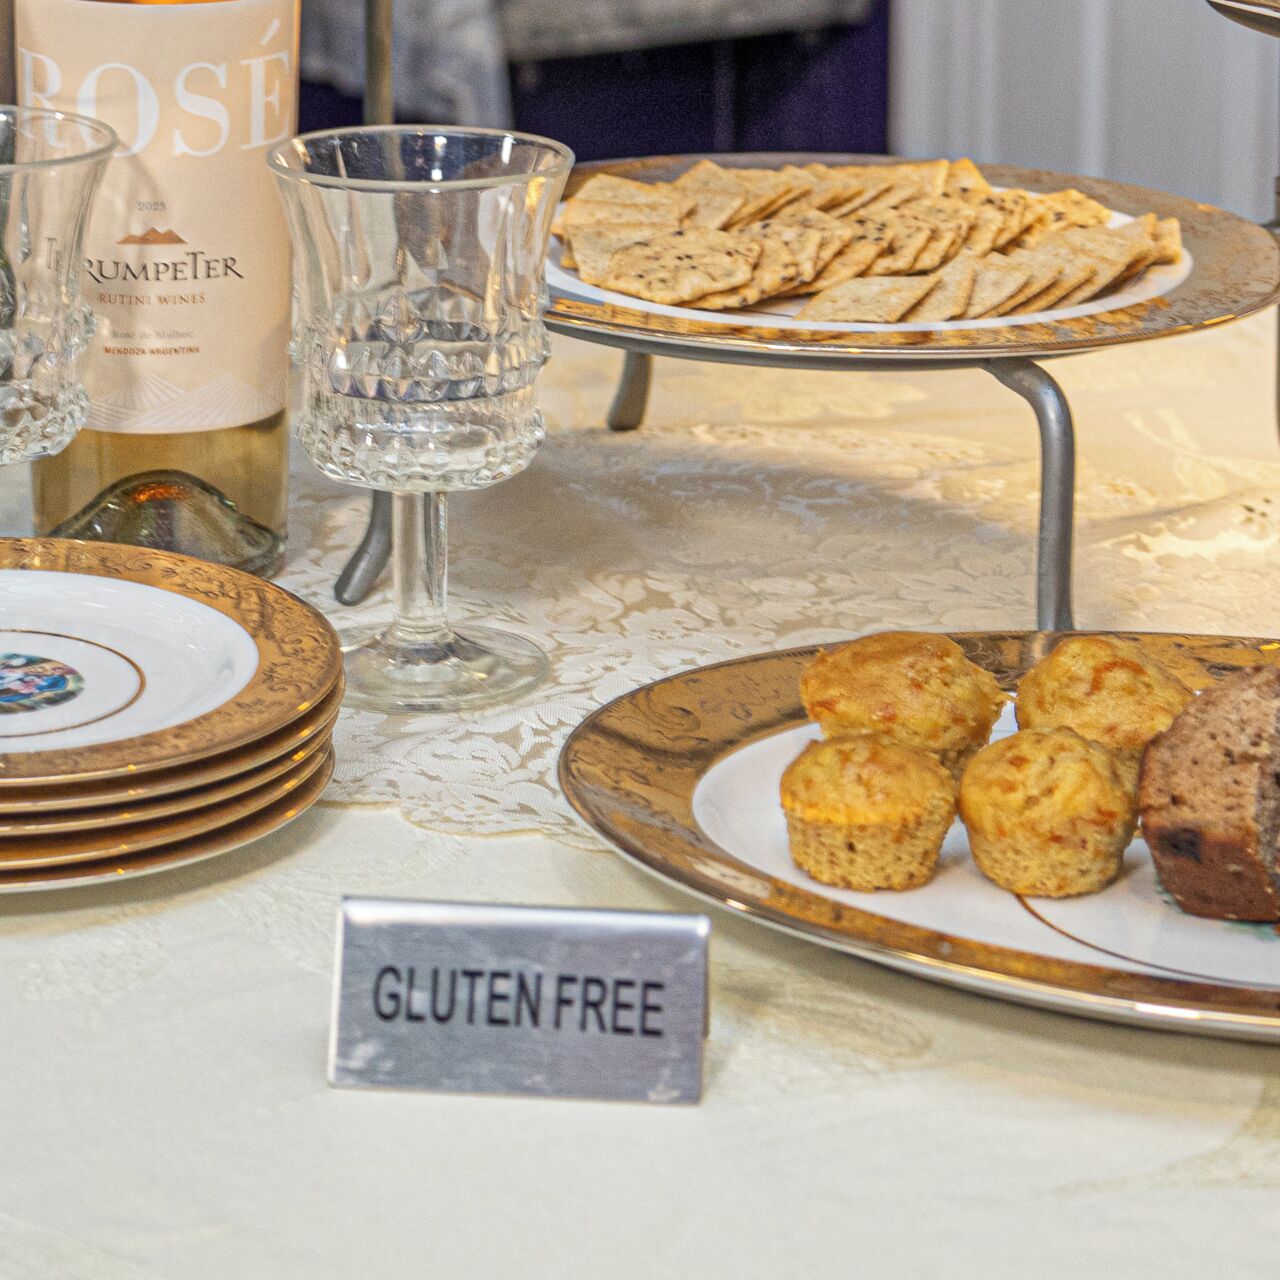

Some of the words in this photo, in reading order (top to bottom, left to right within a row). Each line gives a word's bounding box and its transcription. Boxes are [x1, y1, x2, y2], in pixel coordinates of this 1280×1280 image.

[18, 18, 290, 158] ROSÉ
[98, 293, 151, 305] RUTINI
[158, 292, 206, 305] WINES
[373, 965, 542, 1029] GLUTEN
[553, 974, 665, 1037] FREE
